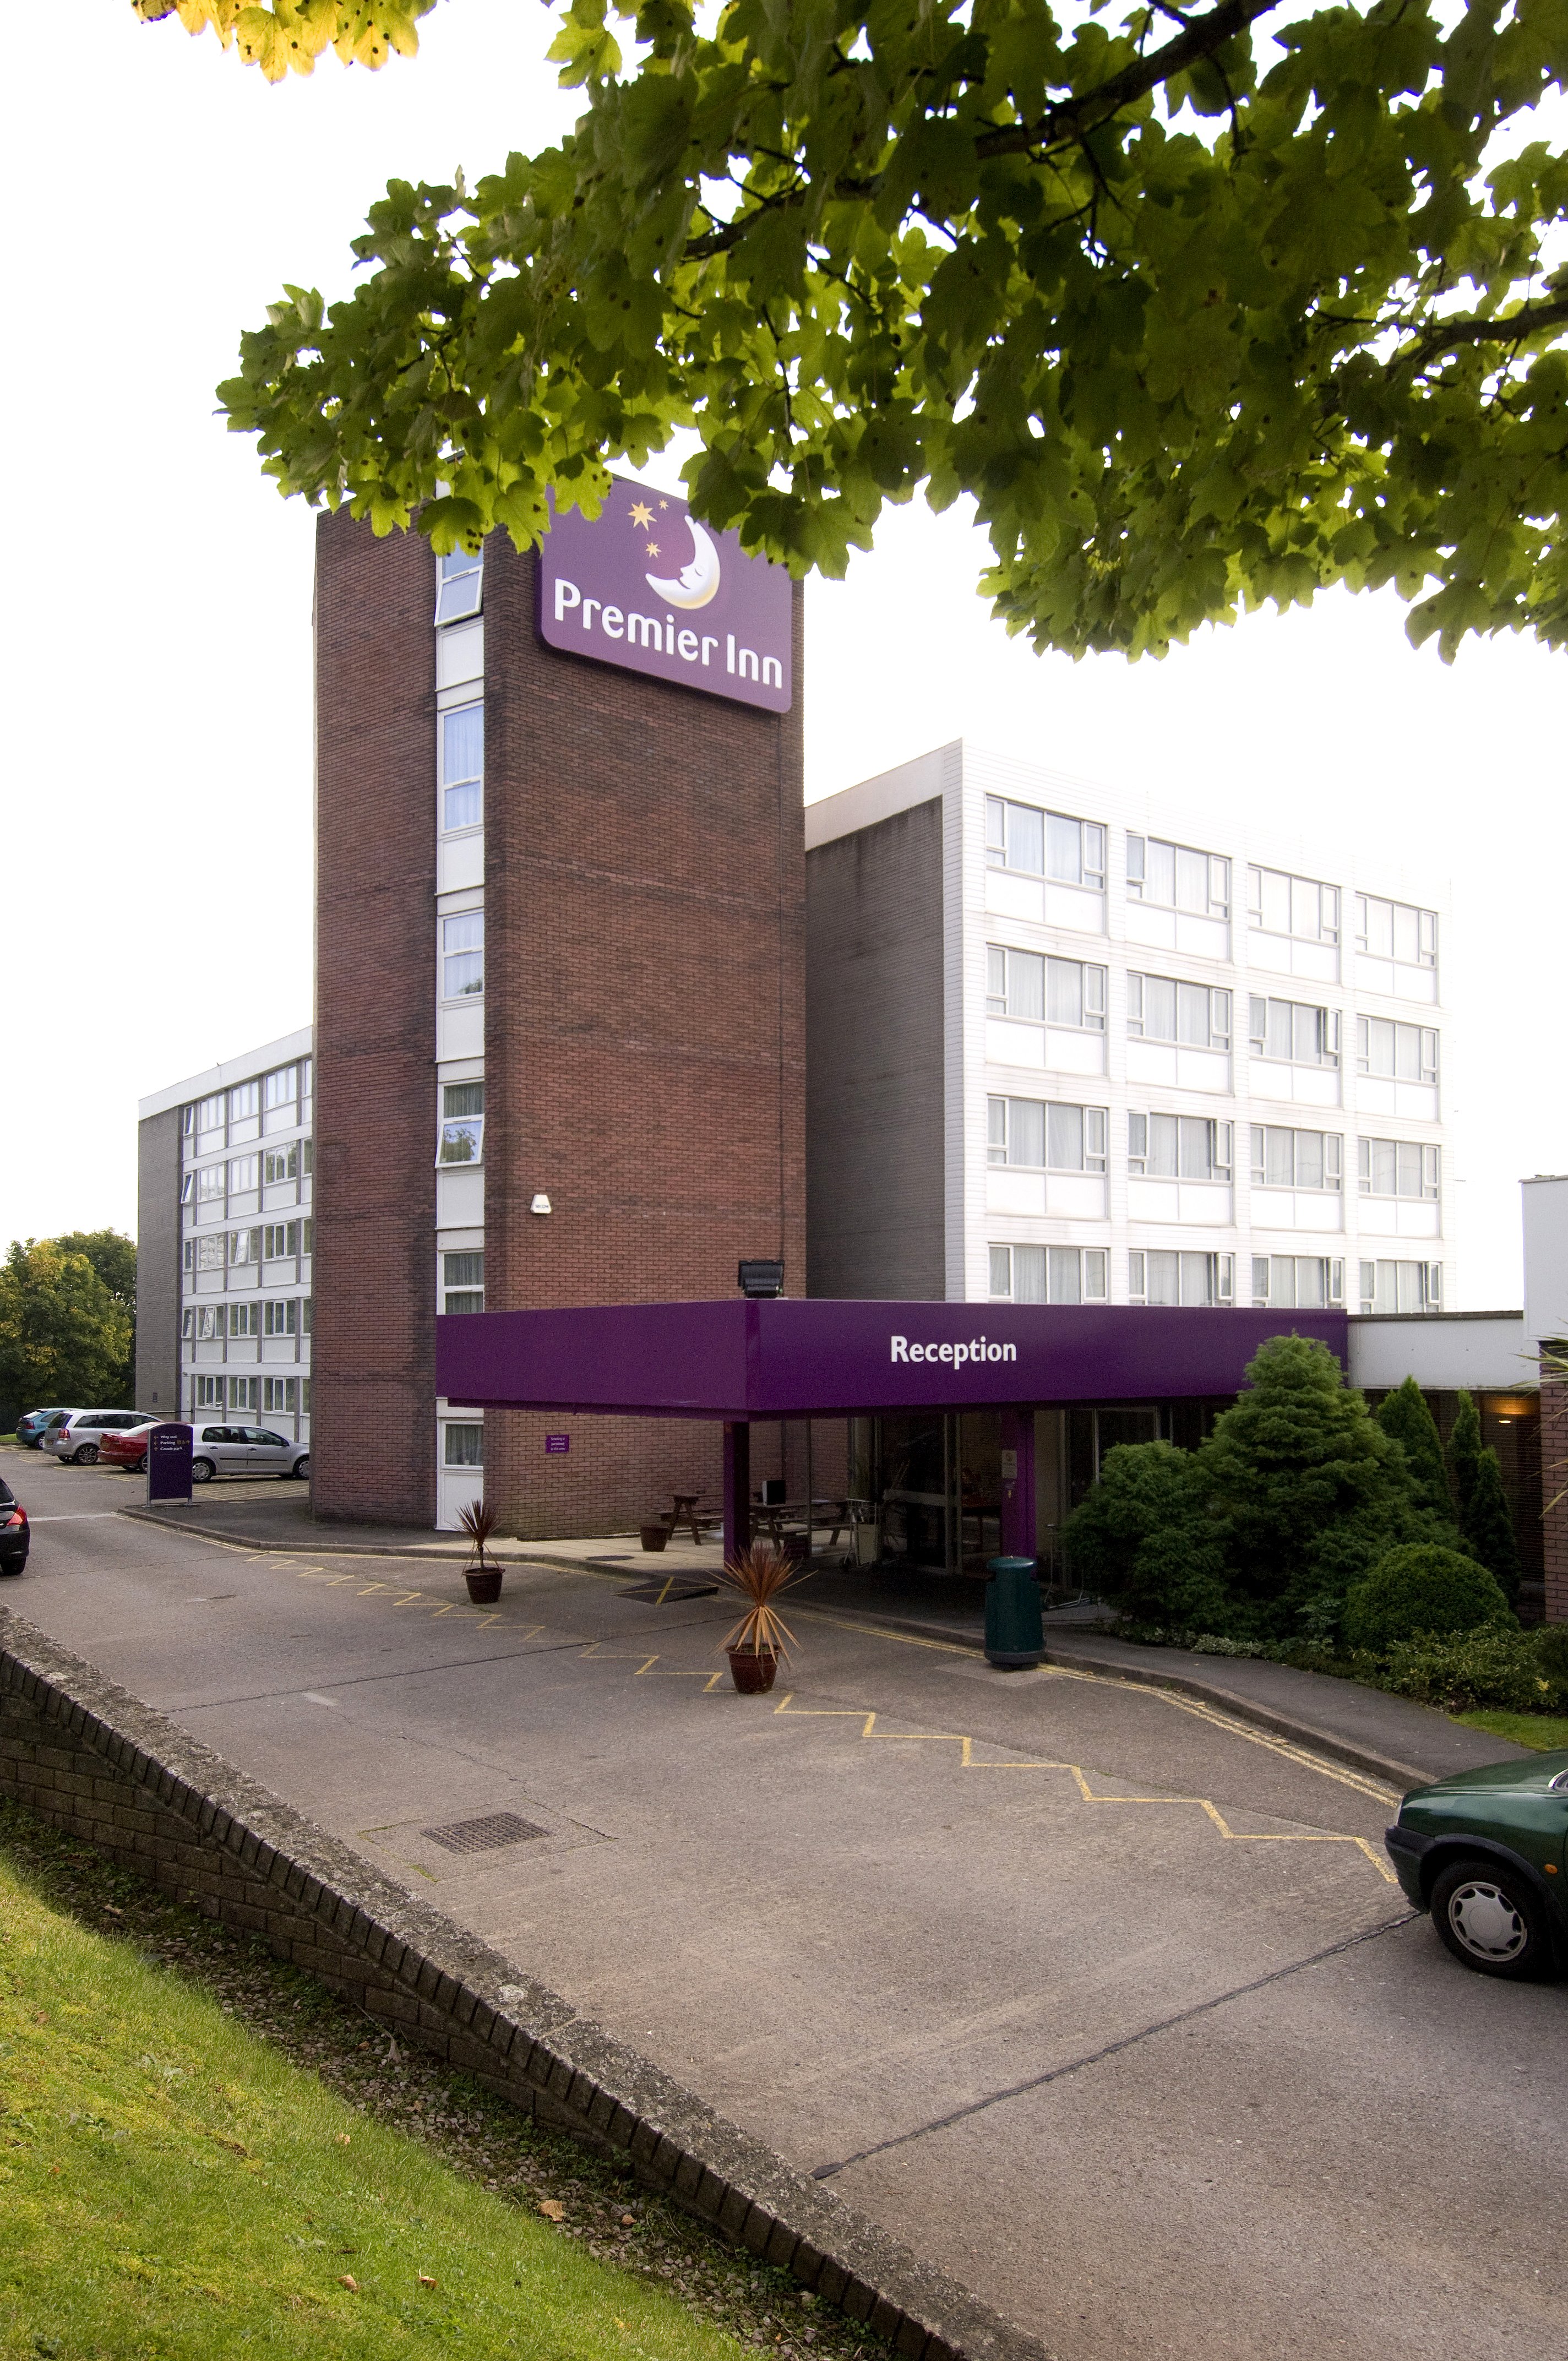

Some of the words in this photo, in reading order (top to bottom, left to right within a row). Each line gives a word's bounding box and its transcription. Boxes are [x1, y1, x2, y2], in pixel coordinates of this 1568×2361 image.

[554, 578, 718, 666] Premier
[727, 634, 782, 689] Inn
[890, 1335, 1017, 1370] Reception
